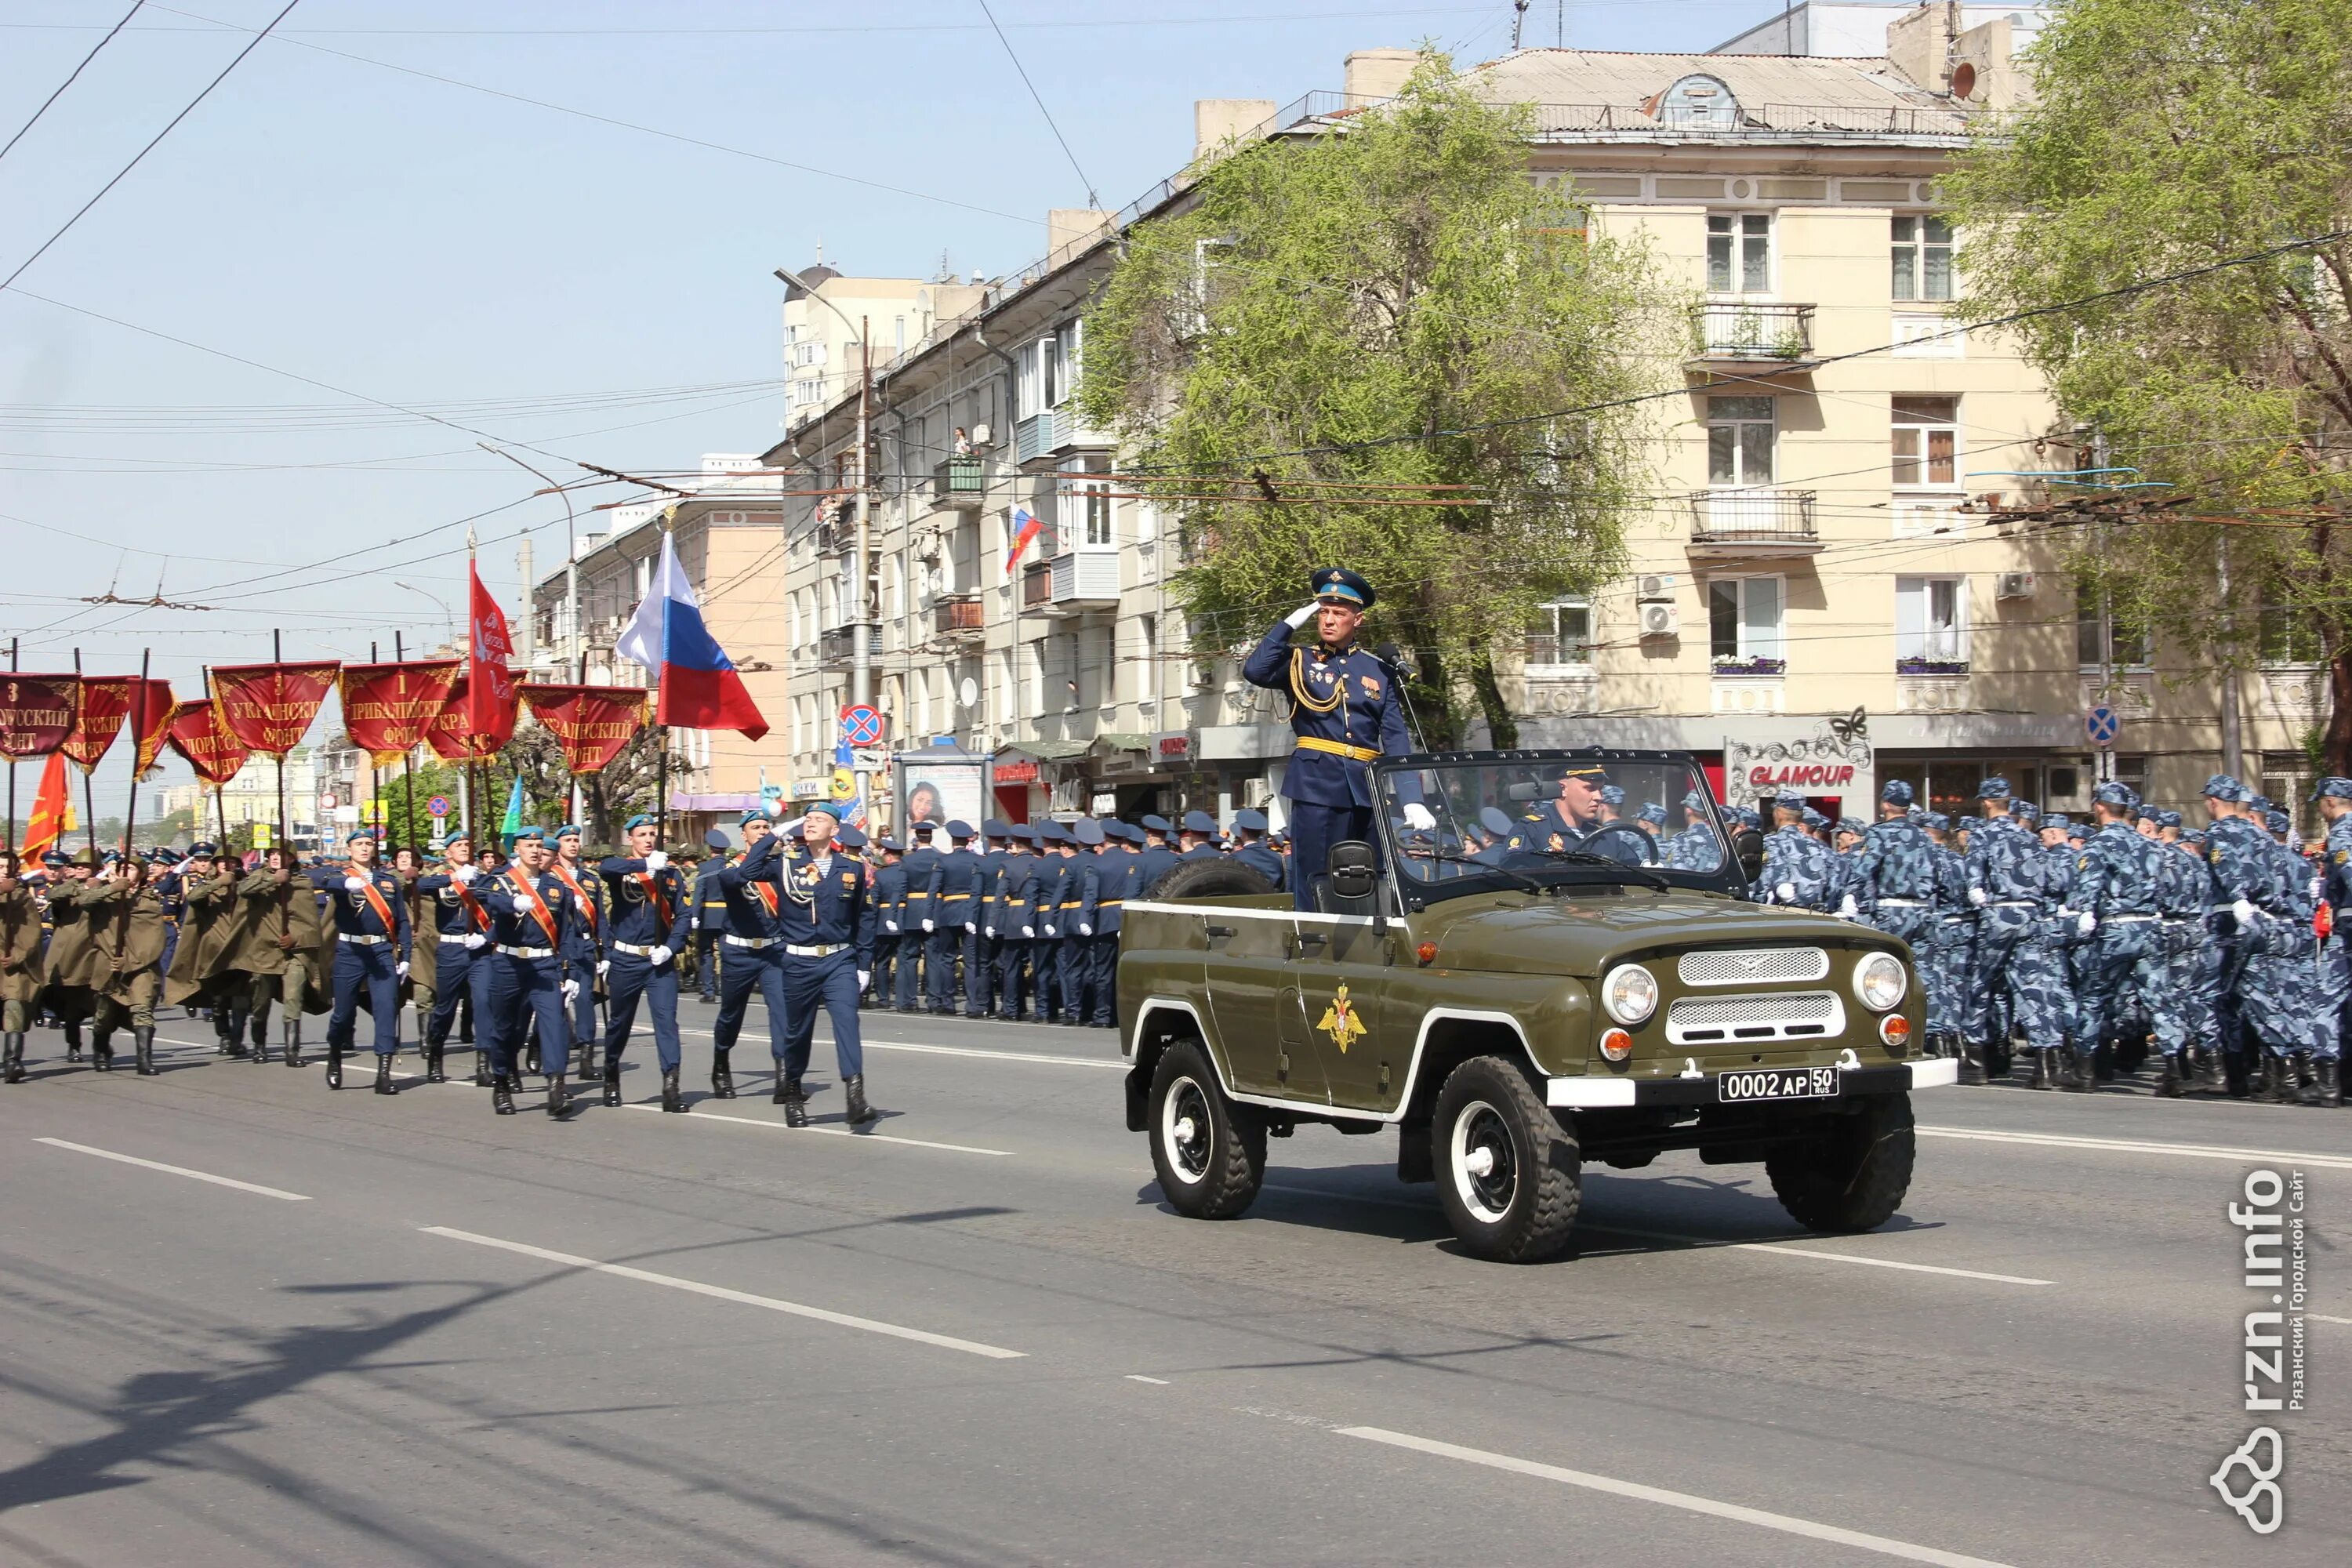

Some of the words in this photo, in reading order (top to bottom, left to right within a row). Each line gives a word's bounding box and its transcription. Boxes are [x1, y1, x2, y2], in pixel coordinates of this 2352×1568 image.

[7, 682, 20, 702] 3
[397, 674, 407, 695] 1
[575, 700, 588, 716] 4
[1749, 764, 1854, 788] GLAMOUR
[1727, 1073, 1779, 1098] 0002
[1813, 1069, 1832, 1087] 50
